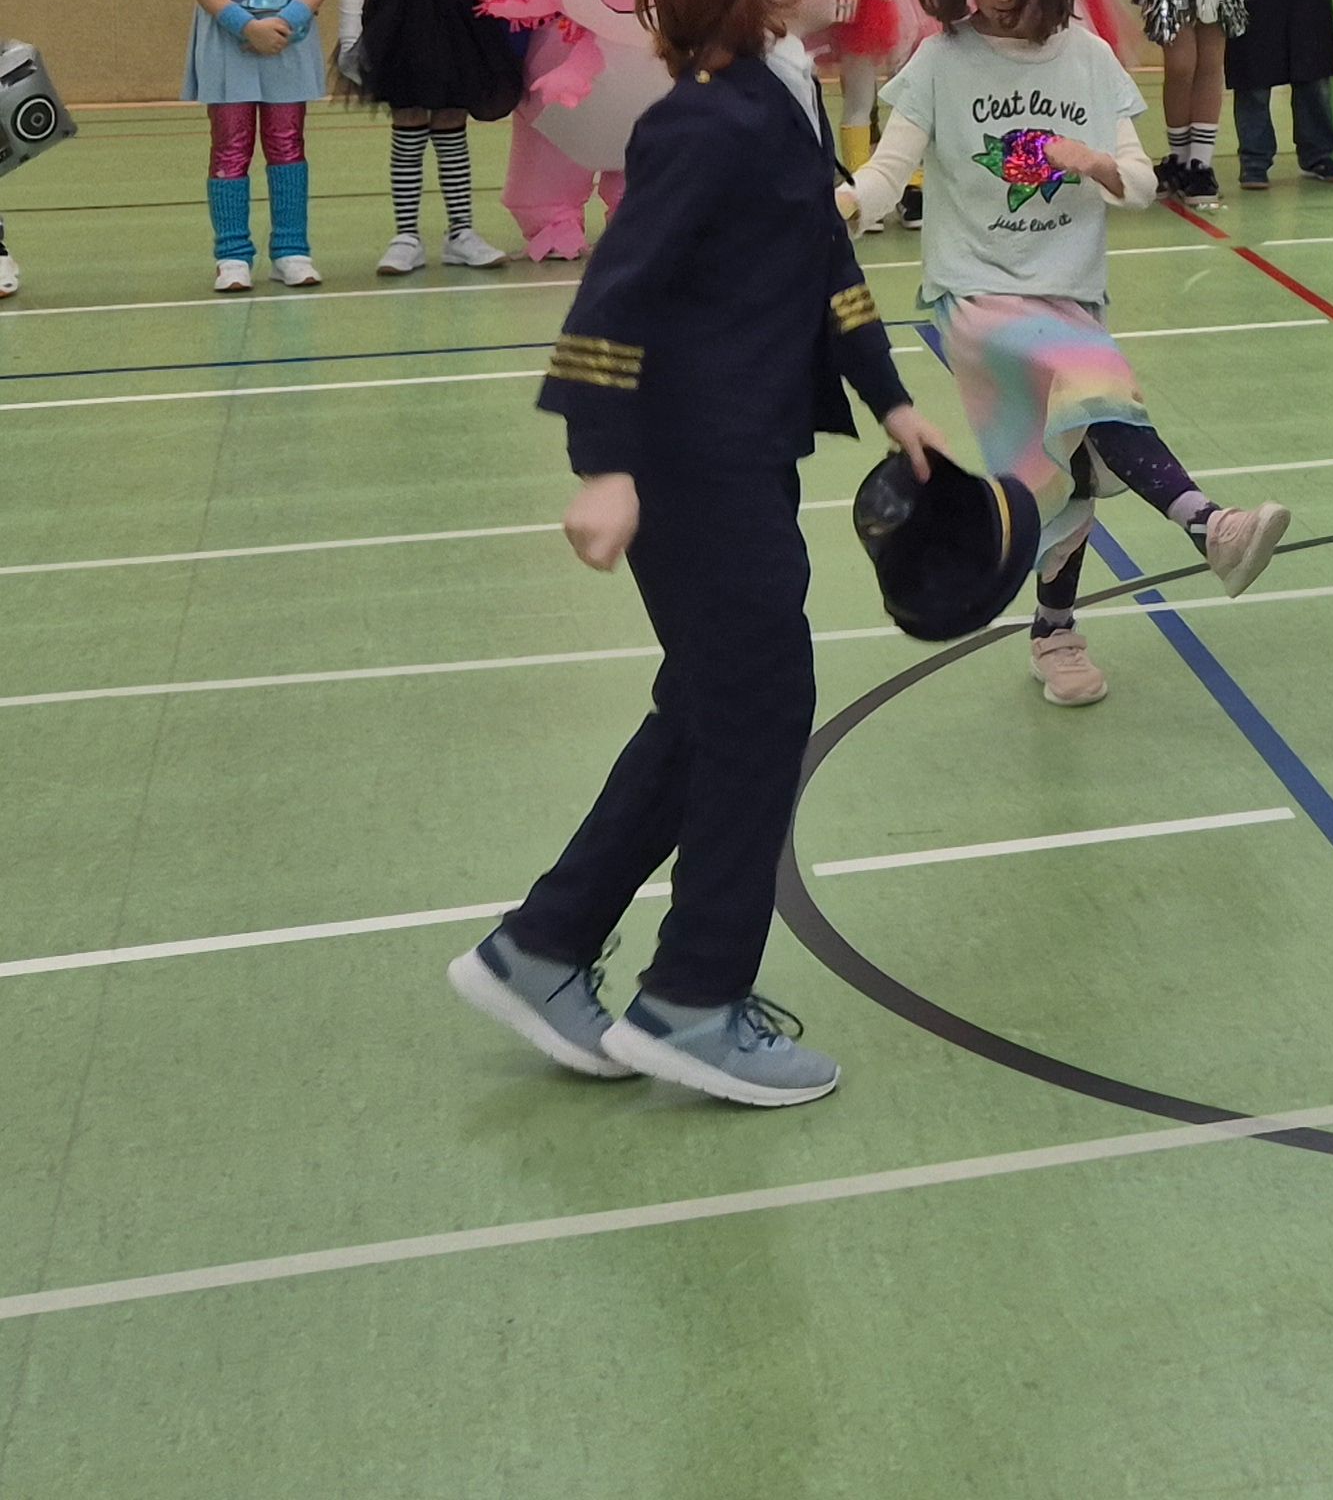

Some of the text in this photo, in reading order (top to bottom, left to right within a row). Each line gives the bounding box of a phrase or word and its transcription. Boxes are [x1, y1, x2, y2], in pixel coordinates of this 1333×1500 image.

[972, 89, 1088, 126] C'est la vie
[1029, 218, 1057, 232] live
[1058, 212, 1072, 226] it
